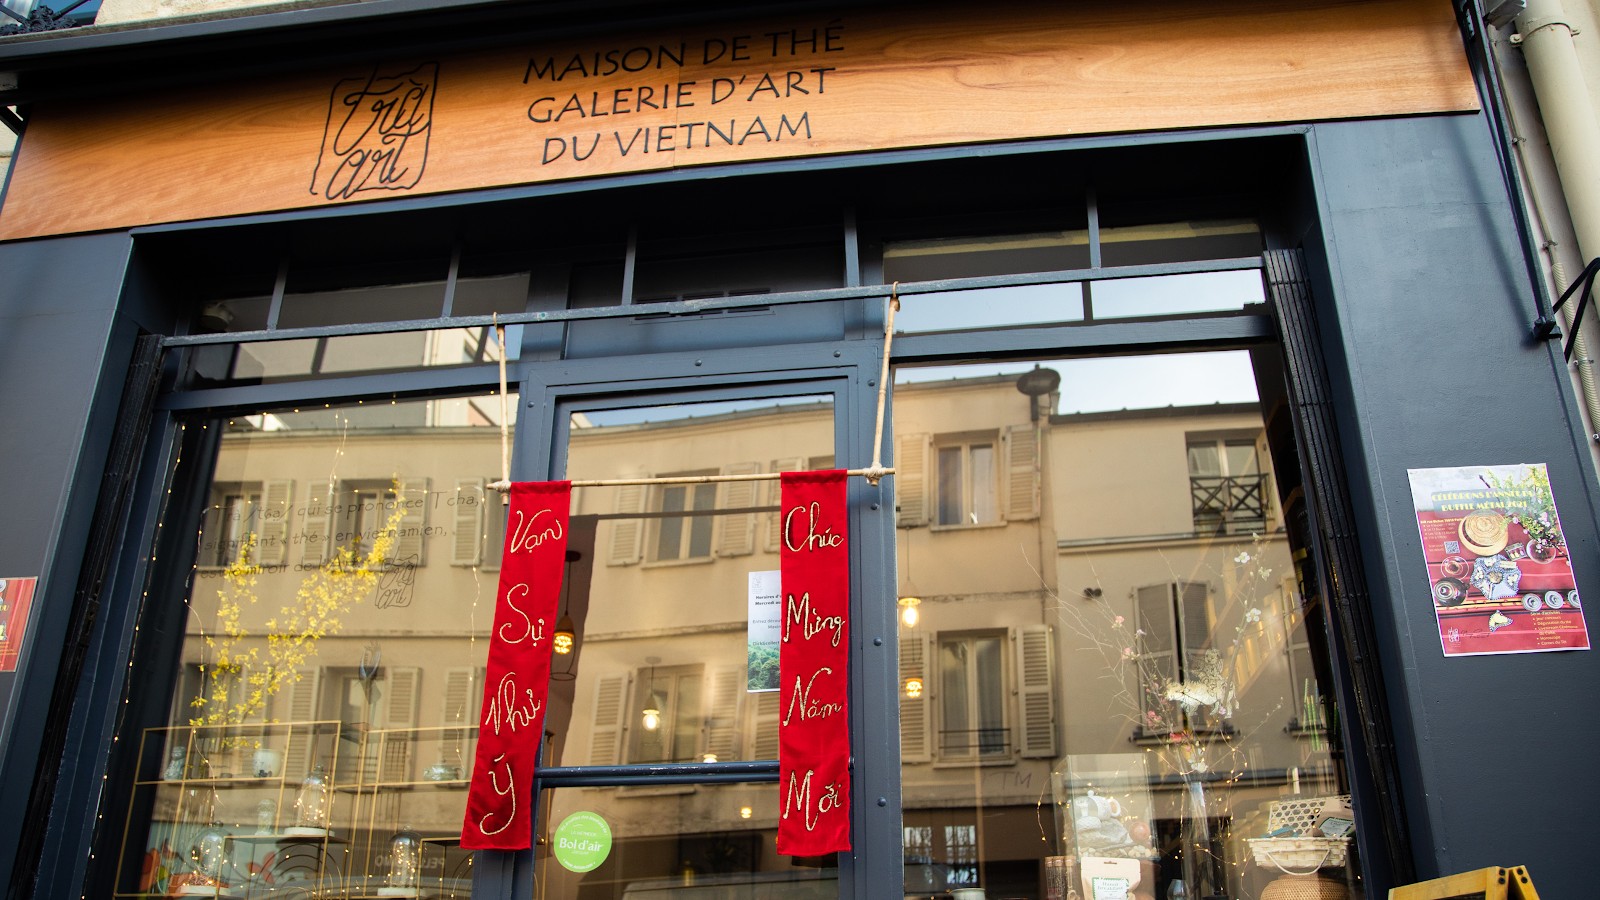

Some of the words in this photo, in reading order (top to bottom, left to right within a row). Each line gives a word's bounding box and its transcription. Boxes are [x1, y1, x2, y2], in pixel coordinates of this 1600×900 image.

[522, 42, 687, 85] MAISON
[702, 36, 751, 66] DE
[764, 18, 845, 59] THÉ
[527, 81, 697, 124] GALERIE
[710, 67, 837, 106] D'ART
[541, 132, 602, 165] DU
[613, 111, 813, 157] VIETNAM
[335, 531, 353, 542] en
[784, 501, 845, 552] Chúc
[559, 837, 577, 850] Bol
[577, 839, 605, 852] d'air
